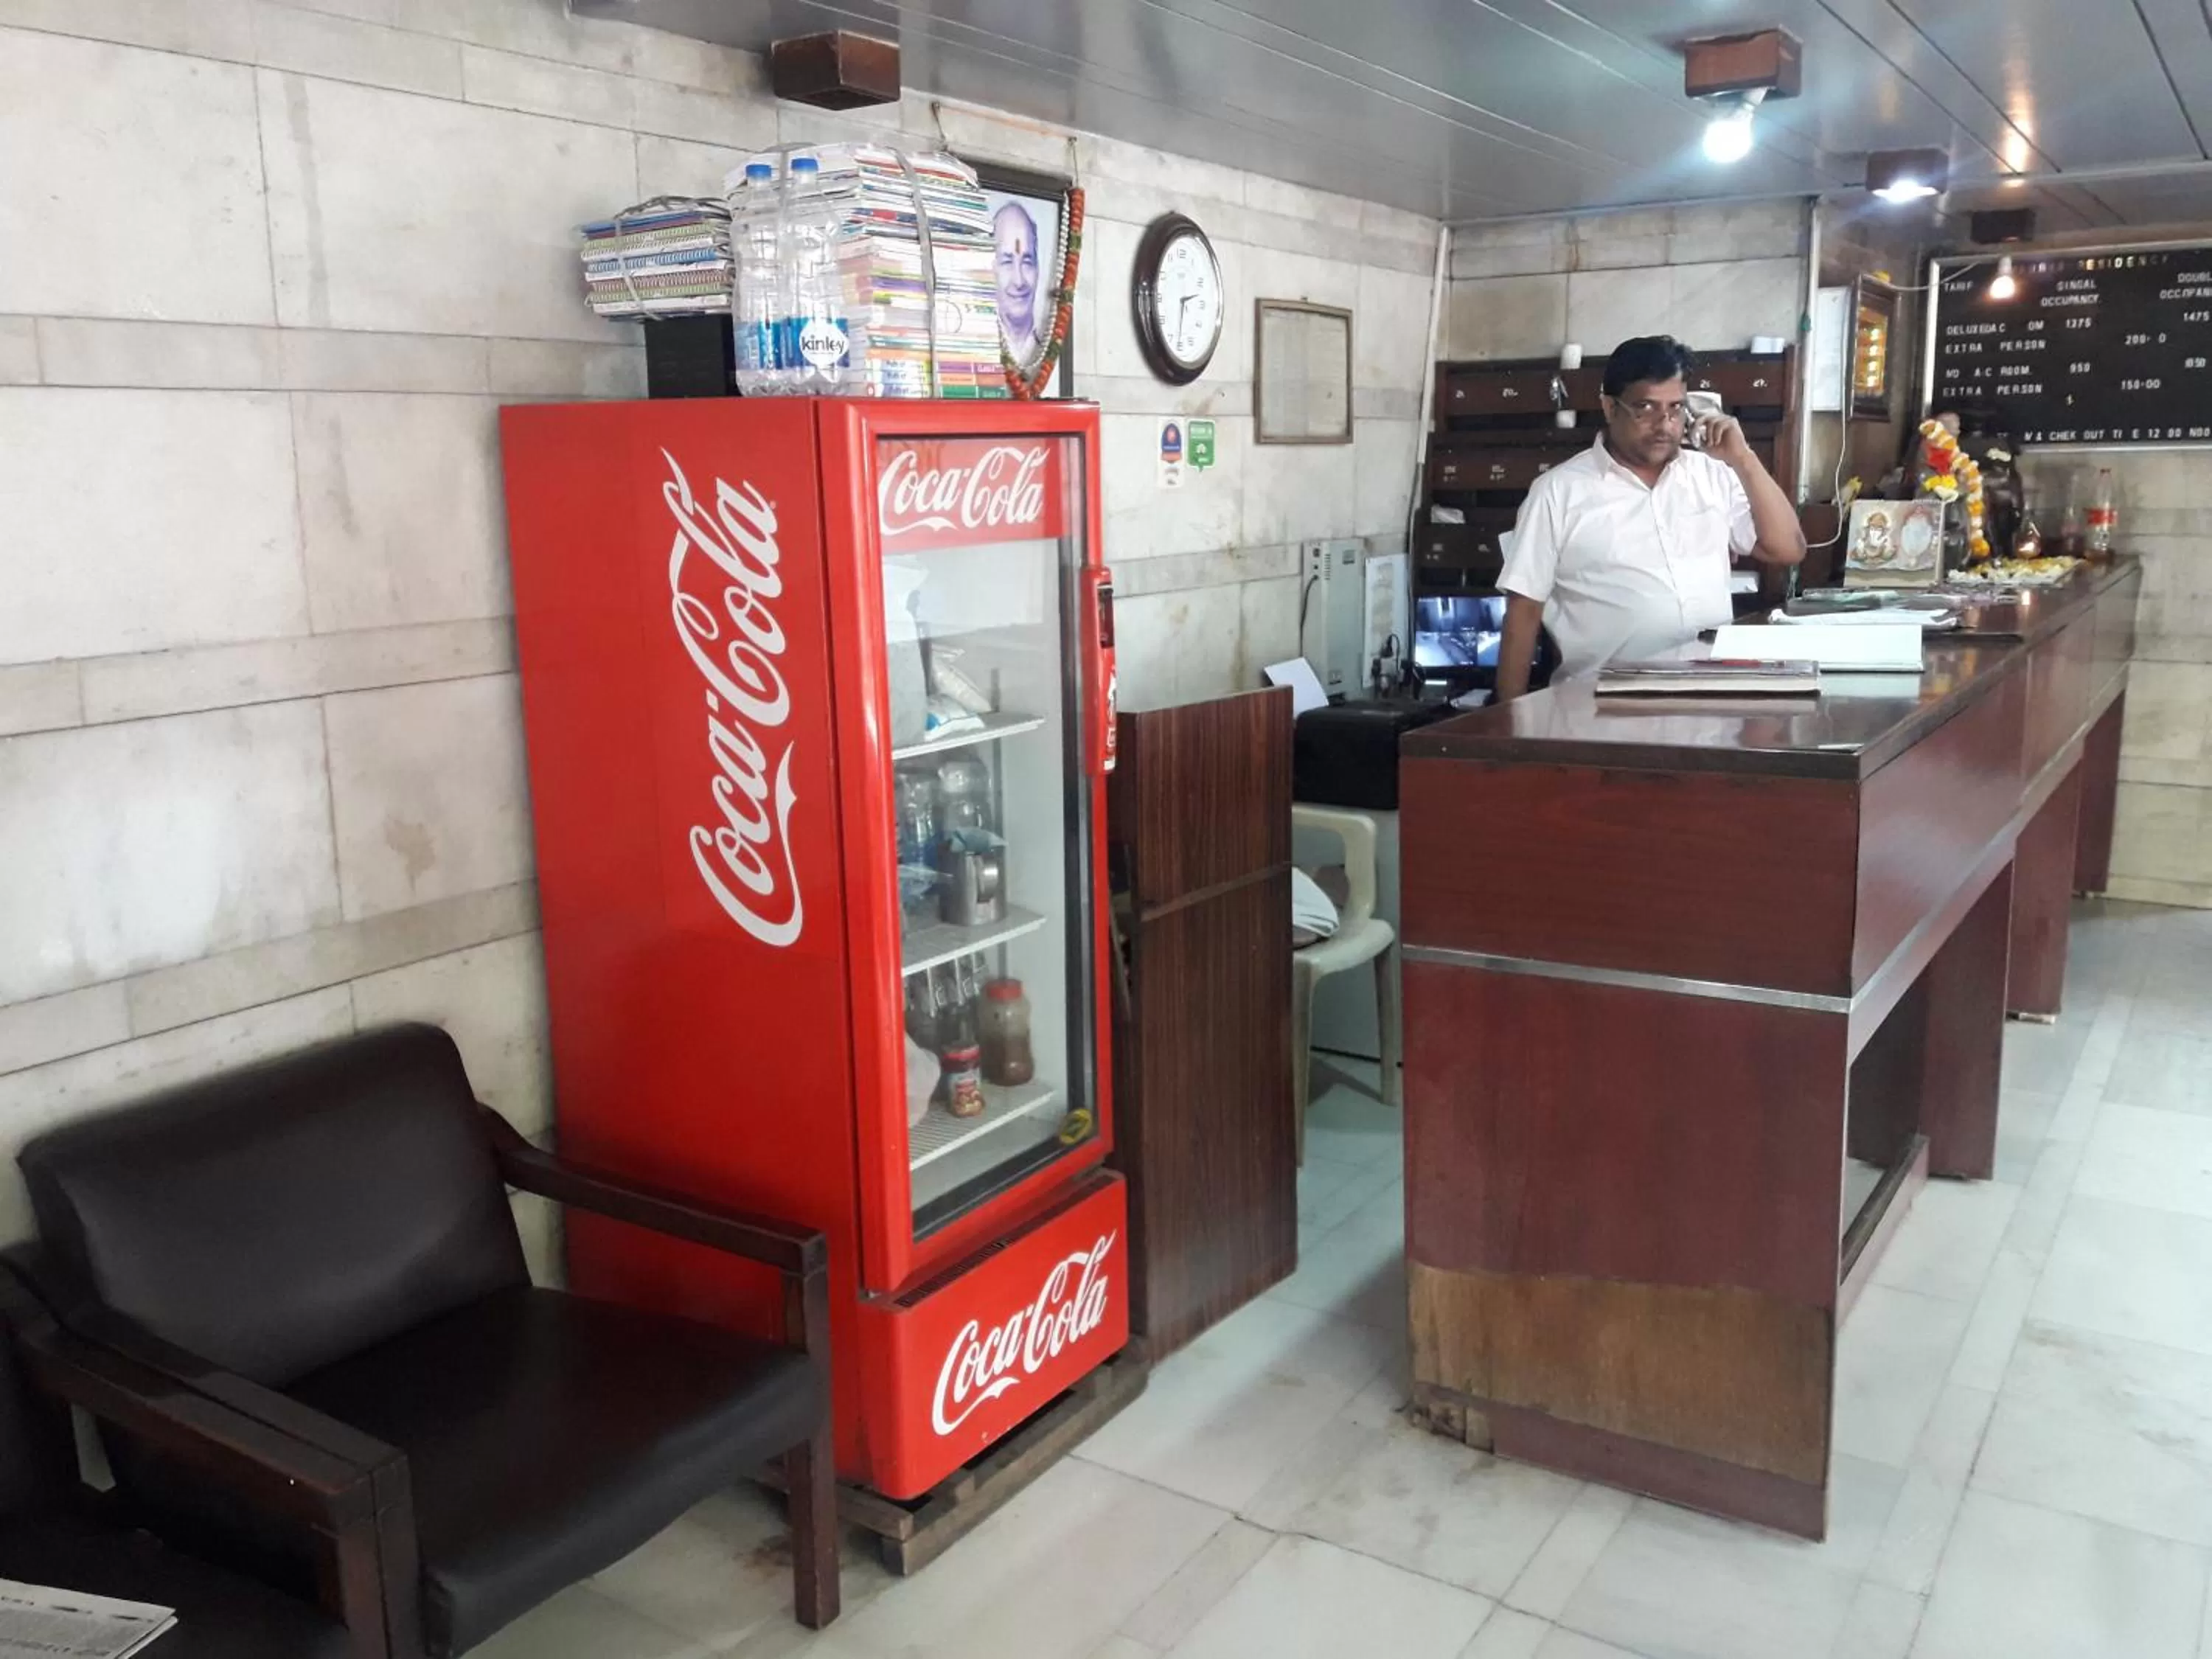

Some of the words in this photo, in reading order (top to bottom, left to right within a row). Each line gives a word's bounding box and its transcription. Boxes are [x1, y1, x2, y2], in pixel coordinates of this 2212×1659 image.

[2183, 310, 2210, 322] 1475
[801, 336, 845, 355] kinley
[1945, 342, 1983, 354] EXTRA
[2000, 339, 2046, 352] PERSON
[1996, 383, 2043, 396] PERSON
[2083, 428, 2105, 440] OUT
